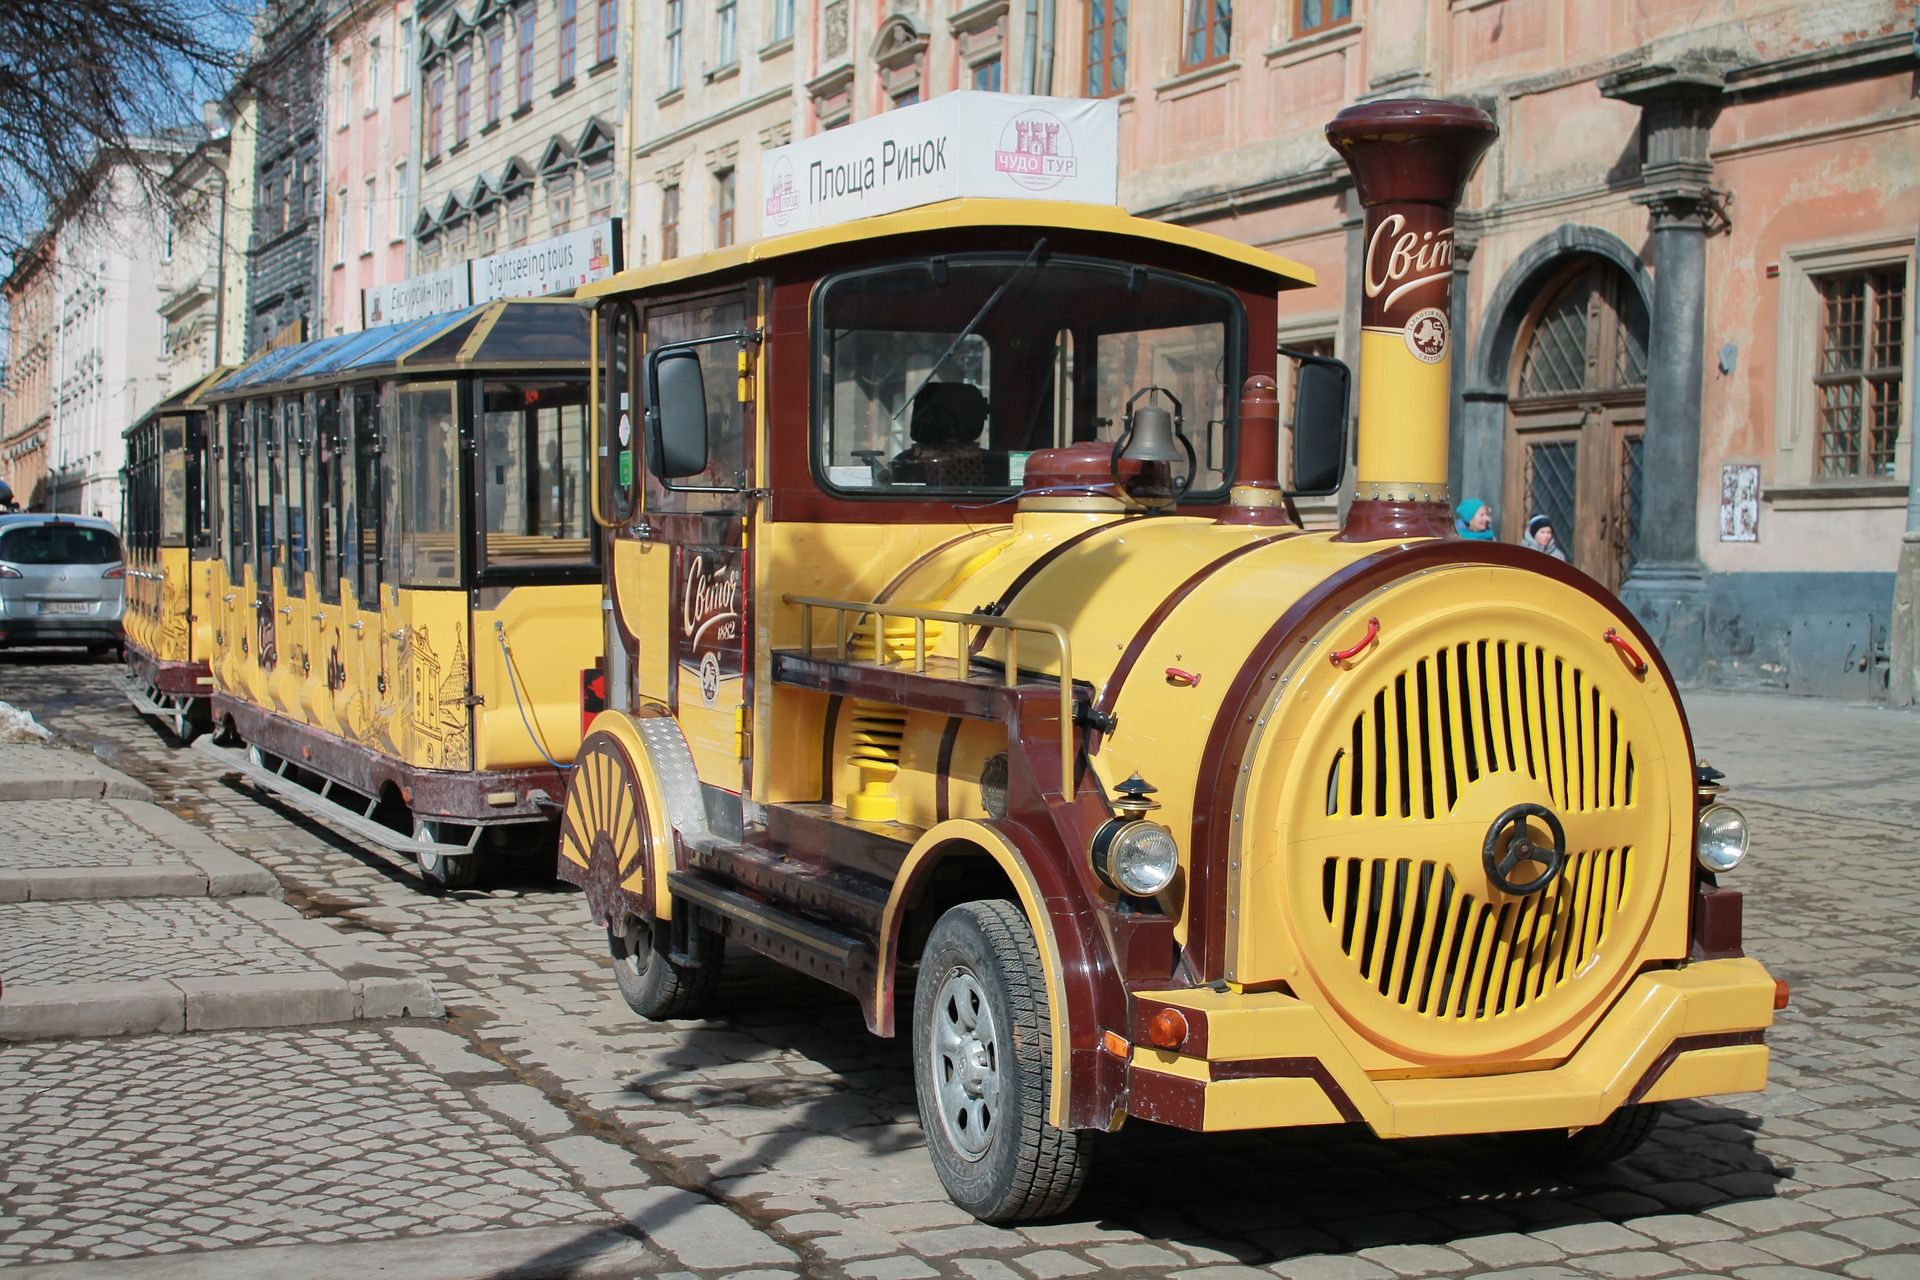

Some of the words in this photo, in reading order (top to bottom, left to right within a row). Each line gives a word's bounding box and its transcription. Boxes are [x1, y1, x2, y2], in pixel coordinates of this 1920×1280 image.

[810, 156, 874, 204] Площа
[882, 136, 947, 186] Ринок
[999, 155, 1038, 172] ЧУДО
[1046, 159, 1074, 173] ТУР
[488, 250, 545, 291] Sightseeing
[547, 244, 574, 271] tours
[684, 555, 737, 637] Світоч
[717, 620, 736, 640] 1882
